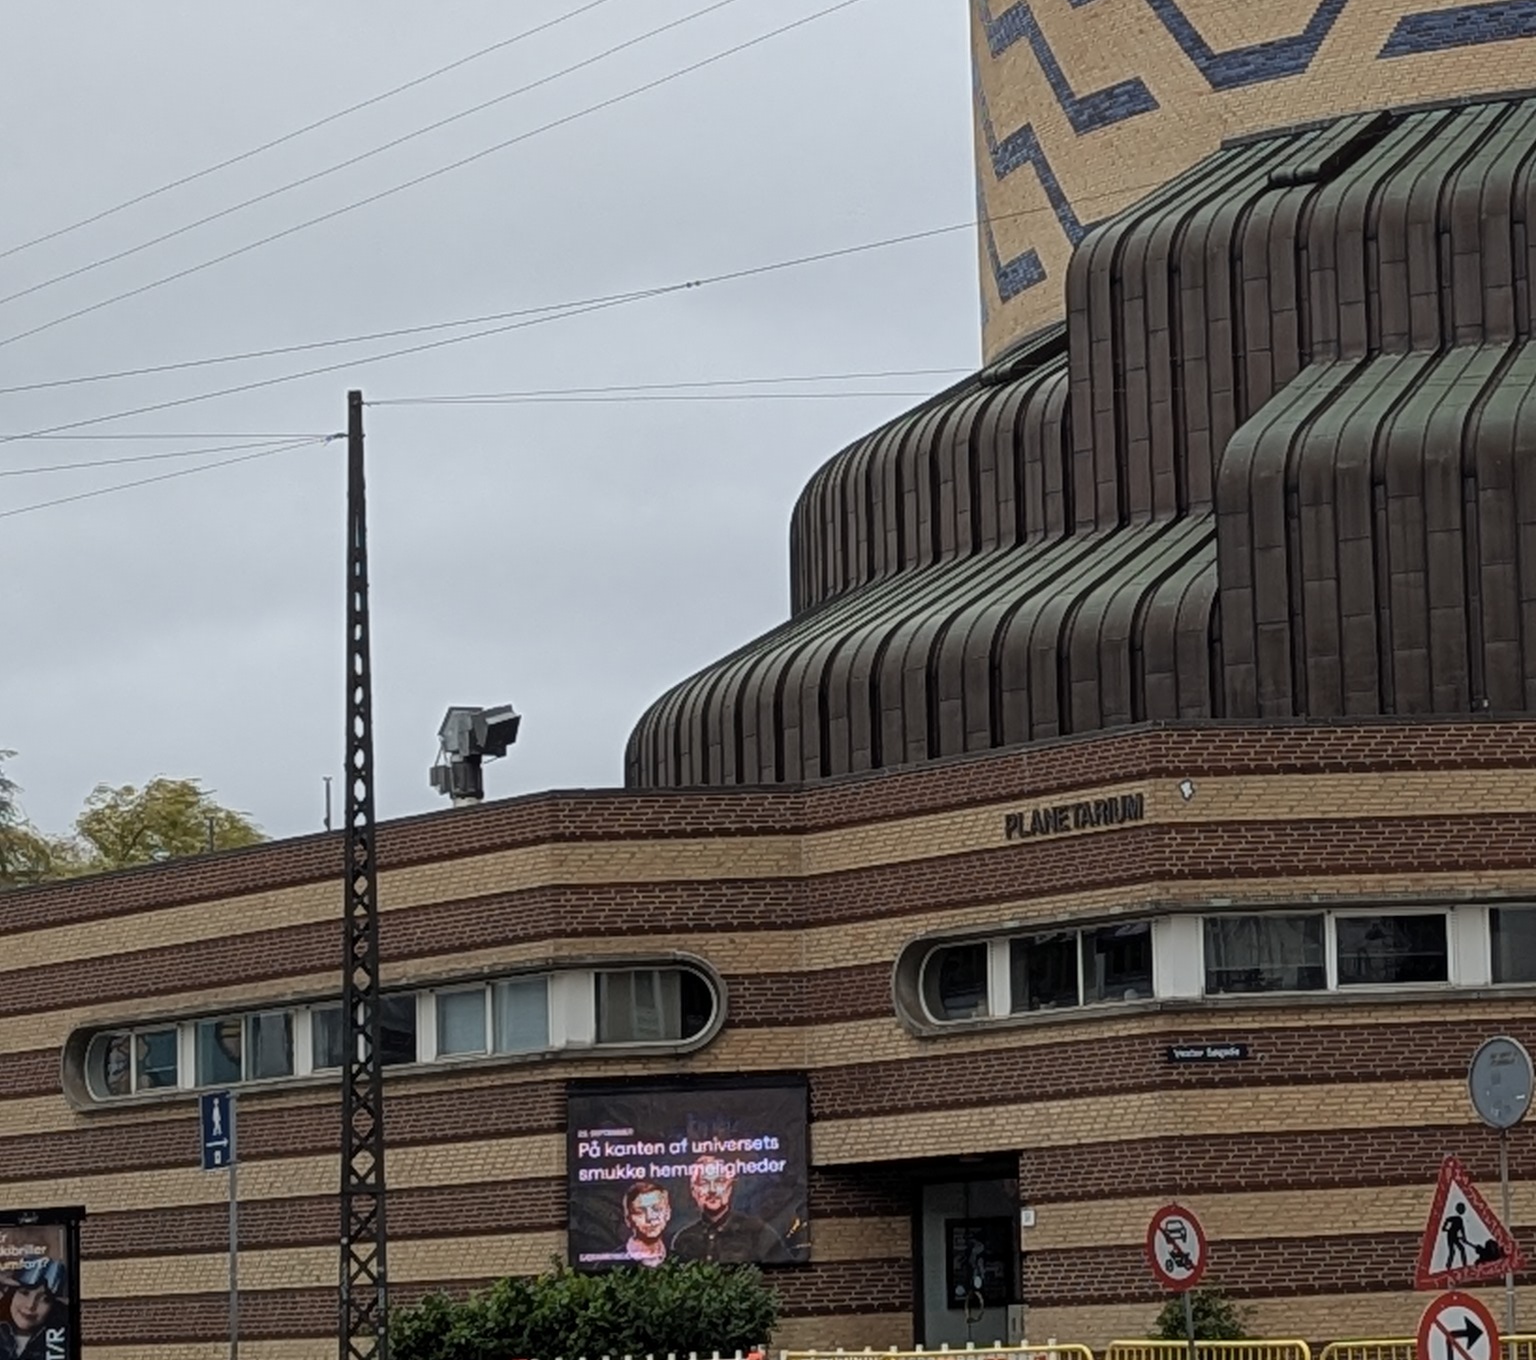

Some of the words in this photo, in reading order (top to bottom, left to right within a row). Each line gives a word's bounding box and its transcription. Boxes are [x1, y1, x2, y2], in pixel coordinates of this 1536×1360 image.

[1005, 793, 1144, 840] PLANETARIUM
[578, 1140, 600, 1158] På
[605, 1141, 665, 1156] kanten
[669, 1138, 688, 1154] af
[692, 1136, 779, 1153] universets
[578, 1164, 645, 1181] smukke
[650, 1158, 786, 1178] hemmeligheder
